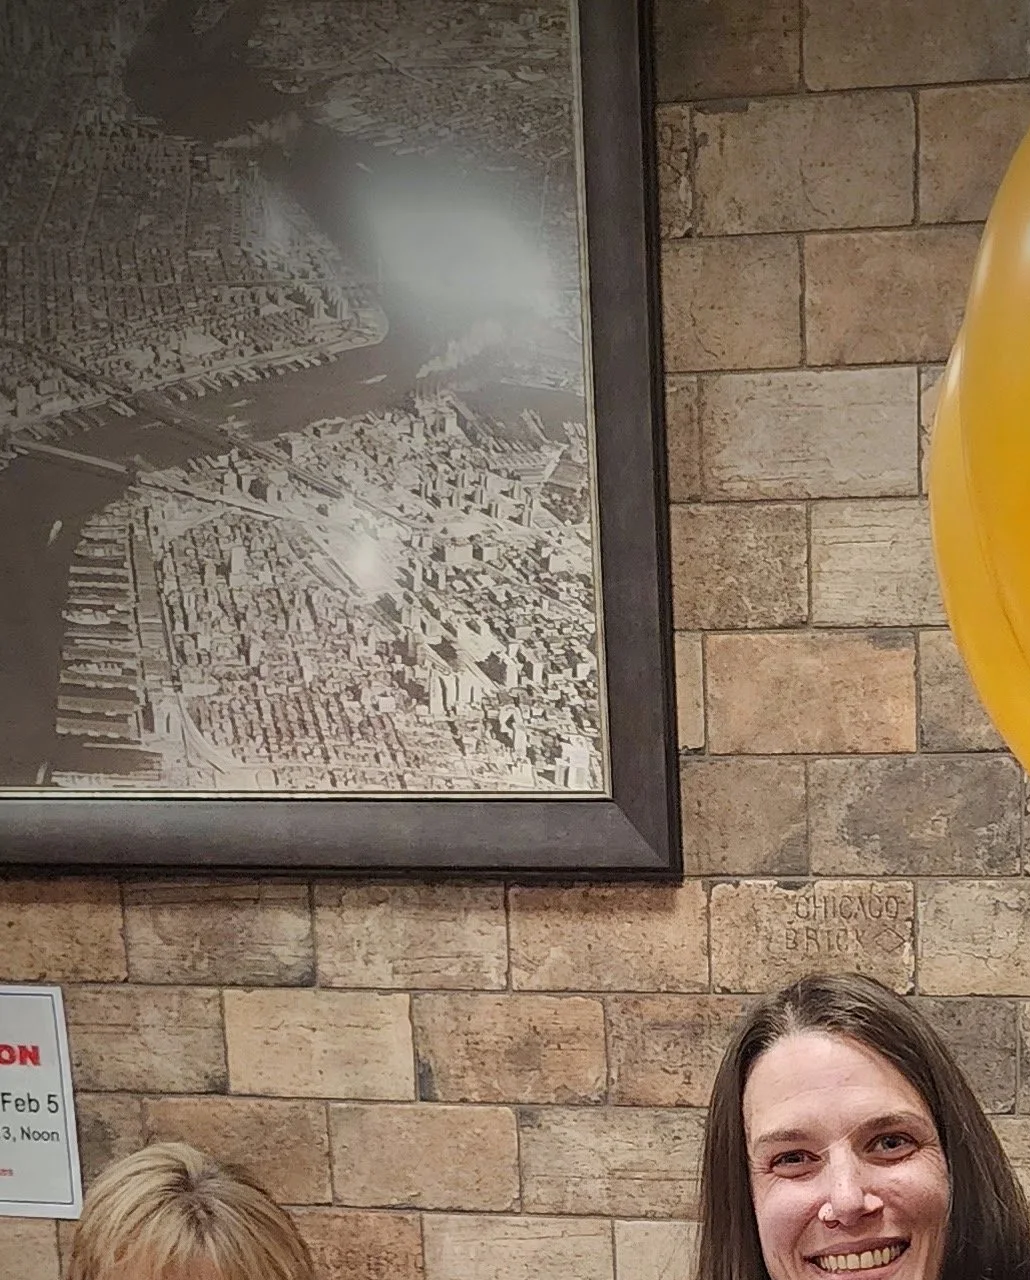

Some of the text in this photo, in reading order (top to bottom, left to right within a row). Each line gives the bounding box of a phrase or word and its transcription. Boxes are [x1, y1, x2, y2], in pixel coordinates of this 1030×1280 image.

[796, 894, 899, 919] CHICAGO
[0, 1044, 41, 1066] ON
[1, 1091, 59, 1113] Feb 5
[20, 1126, 60, 1141] Noon
